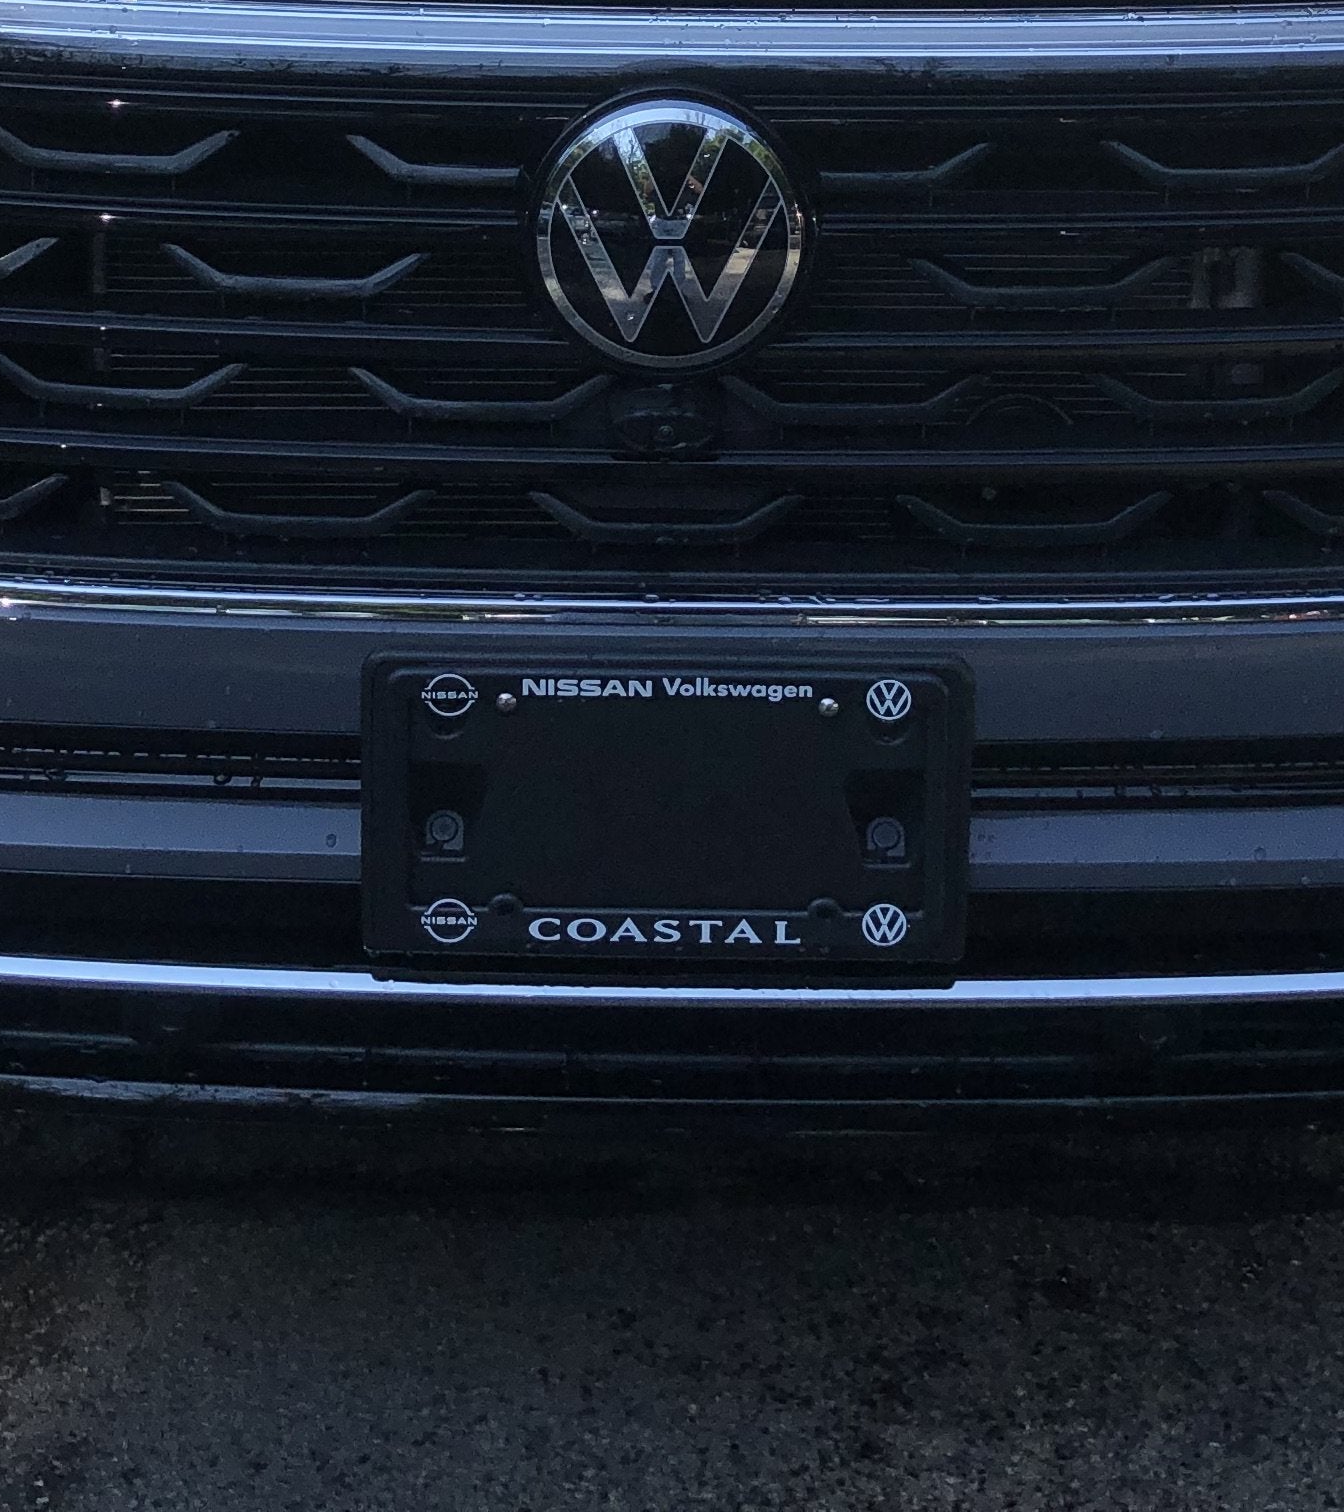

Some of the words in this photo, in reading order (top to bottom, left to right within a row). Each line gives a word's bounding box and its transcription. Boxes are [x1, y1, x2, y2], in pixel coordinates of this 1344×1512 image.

[556, 124, 784, 344] VW
[421, 690, 479, 700] NISSAN
[521, 678, 653, 698] NISSAN
[662, 677, 814, 701] Volkswagen
[869, 682, 909, 717] VW
[420, 916, 478, 926] NISSAN
[528, 917, 801, 943] COASTAL
[865, 907, 906, 942] VW
